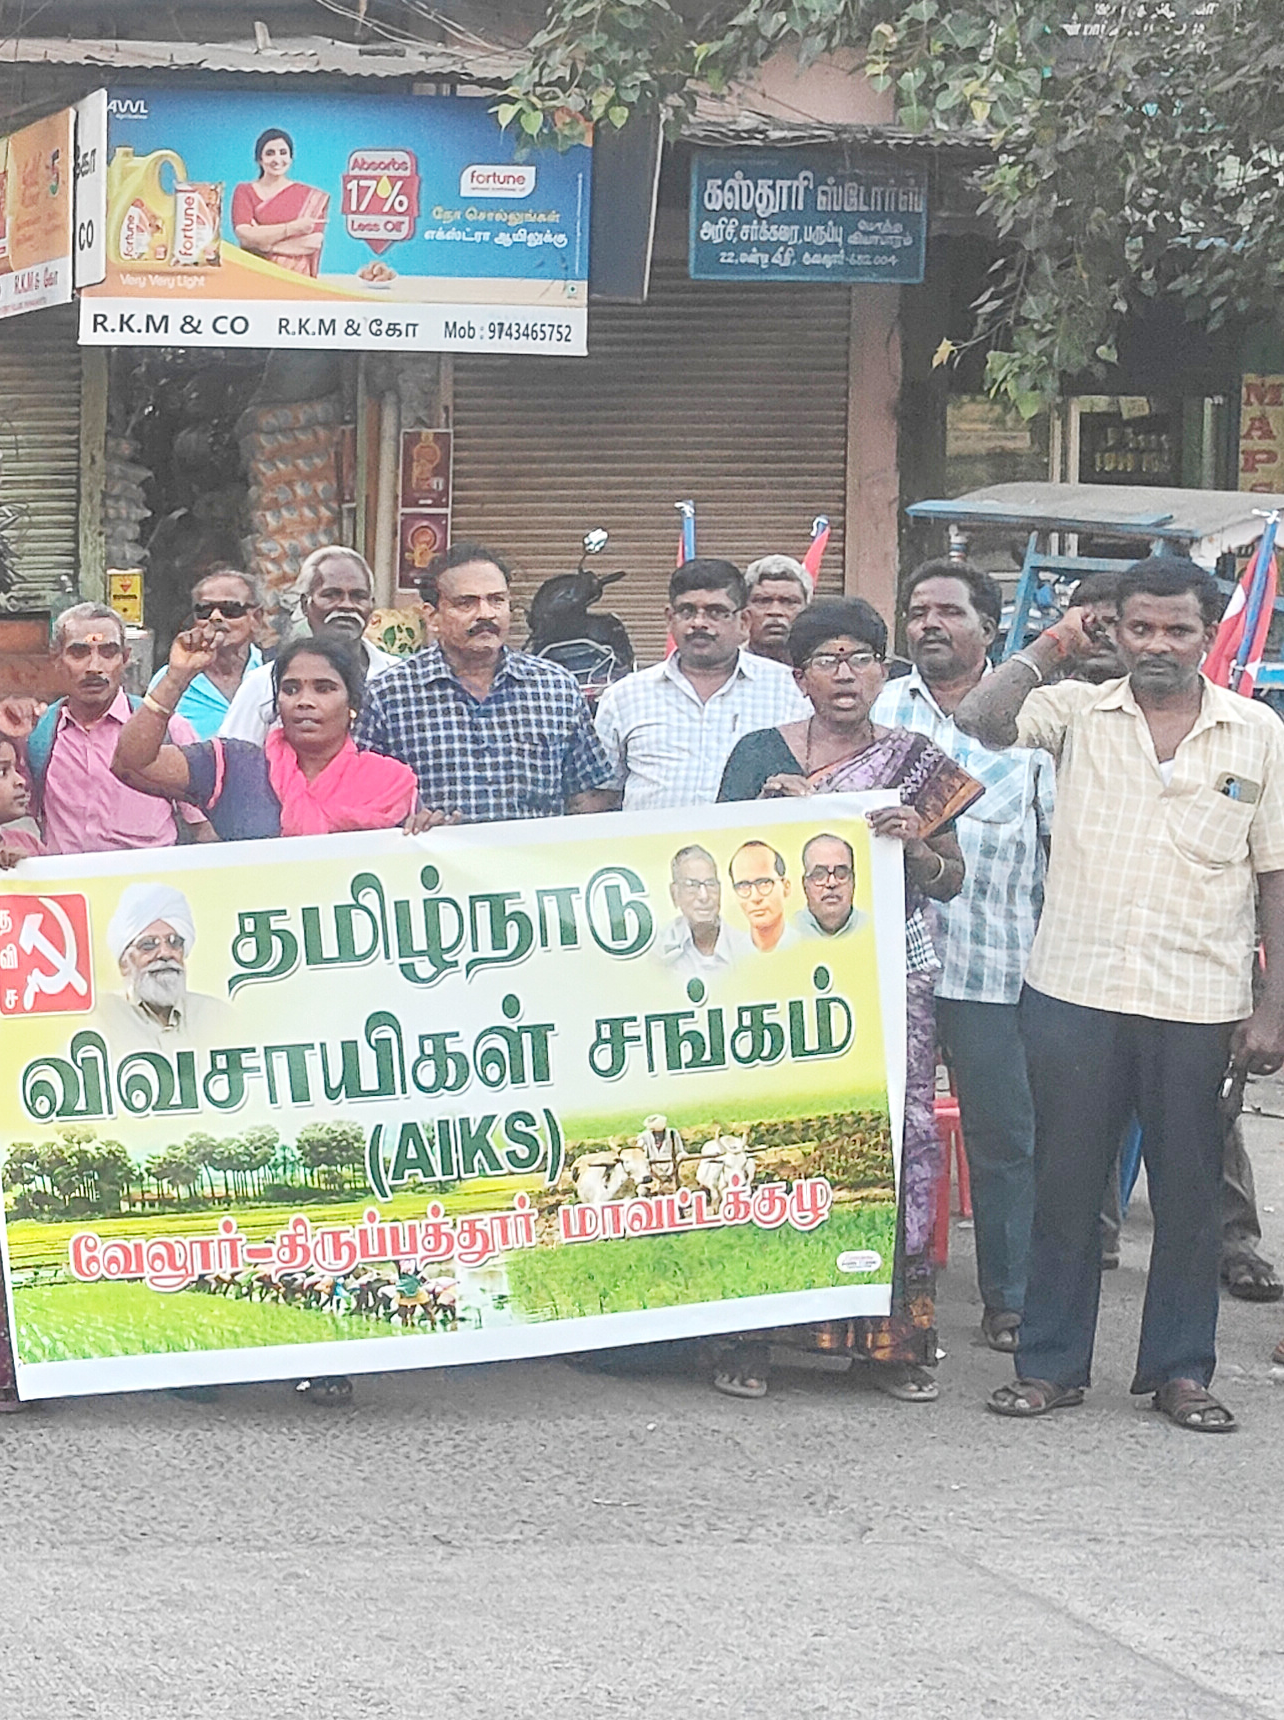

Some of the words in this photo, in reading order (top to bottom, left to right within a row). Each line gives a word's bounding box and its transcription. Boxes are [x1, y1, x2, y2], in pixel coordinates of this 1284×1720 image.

[346, 179, 410, 213] 17%
[470, 170, 527, 186] fortune
[123, 214, 136, 258] fortune
[180, 195, 195, 257] fortune
[119, 273, 147, 288] Very
[148, 274, 176, 288] Very
[92, 313, 170, 335] R.K.M
[179, 314, 204, 335] &
[211, 314, 250, 336] CO
[277, 317, 337, 338] R.K.M
[343, 318, 362, 338] &
[367, 318, 419, 339] கோ
[443, 321, 476, 341] Mob
[227, 864, 657, 999] தமிழ்நாடு
[21, 993, 558, 1122] விவசாயிகள்
[588, 965, 857, 1079] சங்கம்
[364, 1106, 566, 1202] (AIKS)
[67, 1188, 538, 1295] வேலூர்-திருப்பத்தூர்
[562, 1175, 833, 1245] மாவட்டக்குழு
